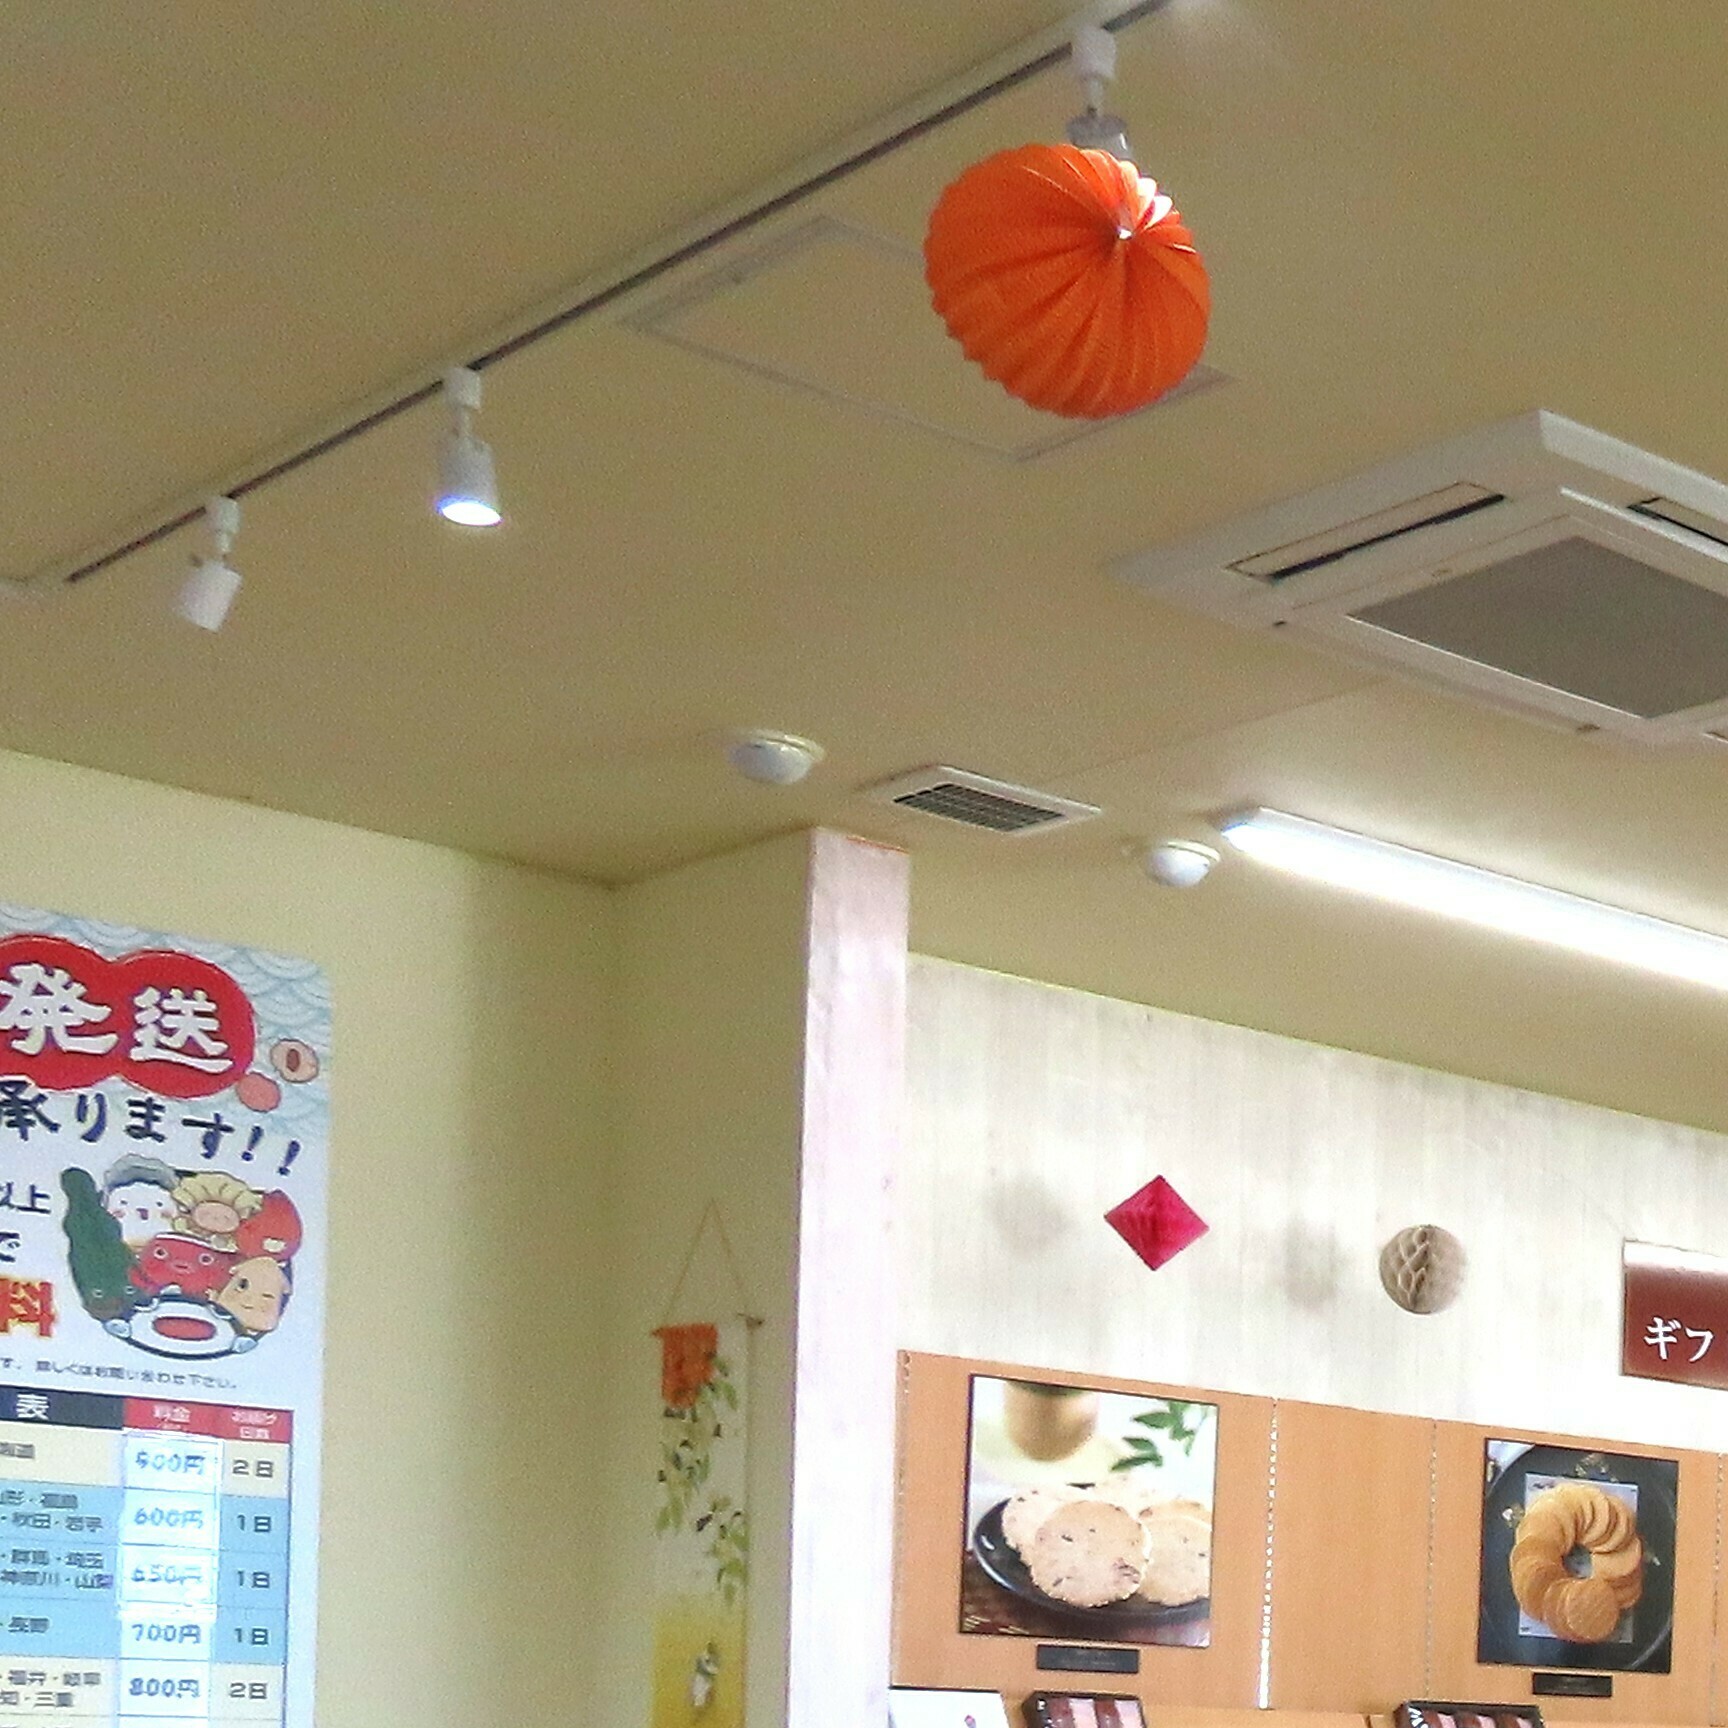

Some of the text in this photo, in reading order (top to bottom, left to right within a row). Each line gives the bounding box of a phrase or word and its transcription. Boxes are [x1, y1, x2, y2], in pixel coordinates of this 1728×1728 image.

[231, 1459, 274, 1478] 2日
[236, 1513, 273, 1533] 1日
[236, 1569, 271, 1590] 1日
[131, 1622, 202, 1645] 700円
[233, 1626, 270, 1646] 1日
[229, 1681, 268, 1700] 2日
